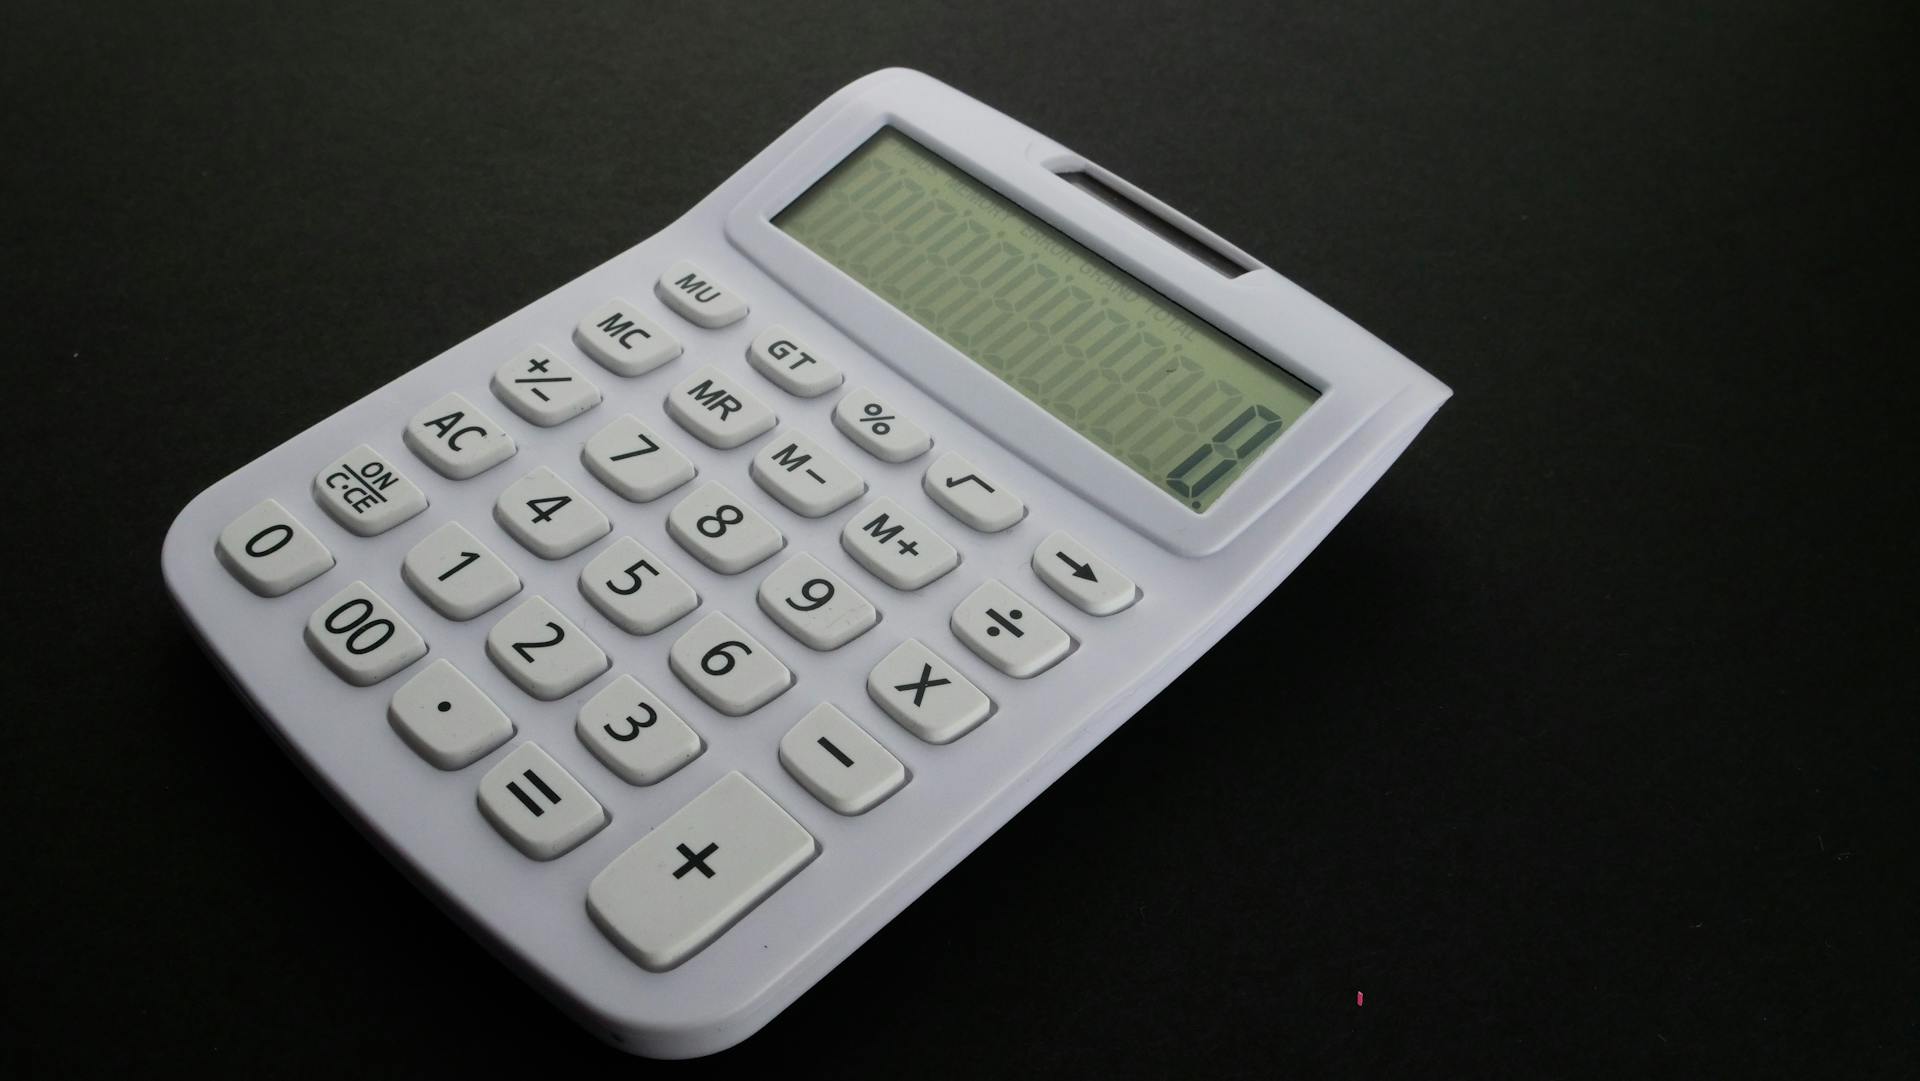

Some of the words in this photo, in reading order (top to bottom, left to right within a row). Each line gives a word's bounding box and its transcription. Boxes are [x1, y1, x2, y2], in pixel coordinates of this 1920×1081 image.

[674, 273, 721, 303] MU
[1080, 261, 1143, 303] GRAND
[1145, 302, 1196, 342] TOTAL
[596, 312, 651, 351] MC
[767, 340, 817, 370] GT
[687, 379, 743, 422] MR
[423, 411, 488, 452] AC
[859, 403, 895, 436] %
[609, 433, 660, 462] 7
[360, 461, 400, 491] ON
[525, 495, 573, 524] 4
[696, 504, 744, 539] 8
[244, 524, 294, 558] 0
[862, 513, 920, 557] M+
[437, 551, 481, 582] 1
[605, 559, 660, 596] 5
[785, 578, 835, 612] 9
[324, 598, 396, 656] 00
[511, 621, 565, 664] 2
[700, 640, 753, 677] 6
[603, 701, 658, 742] 3
